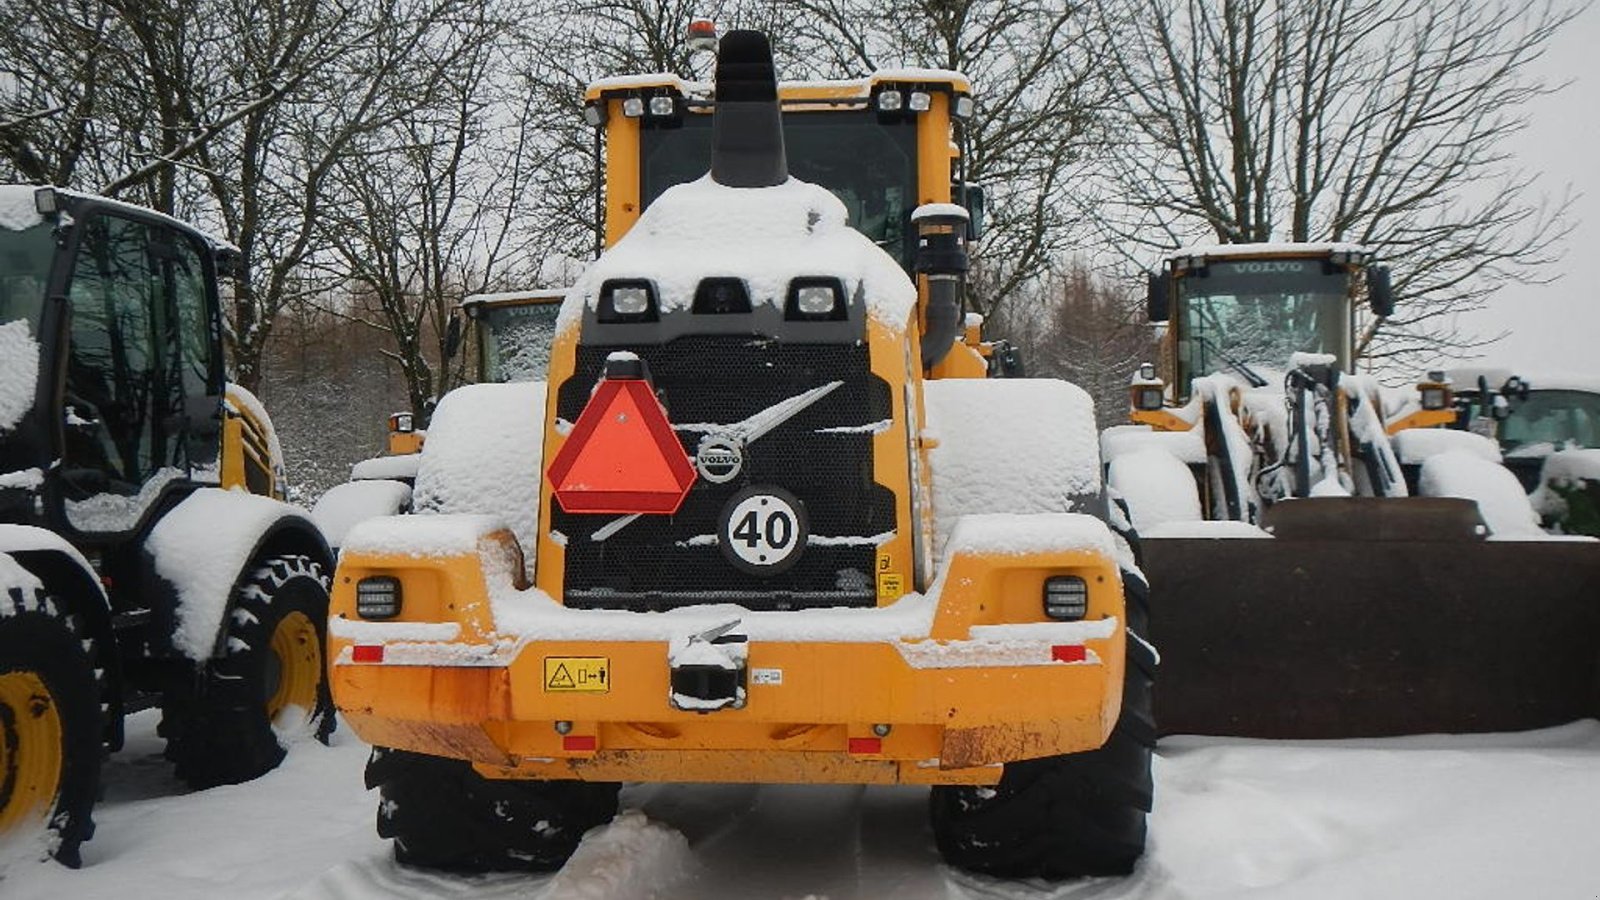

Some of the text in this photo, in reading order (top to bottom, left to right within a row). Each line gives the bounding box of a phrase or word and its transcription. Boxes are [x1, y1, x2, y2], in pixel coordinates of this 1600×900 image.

[1233, 262, 1303, 273] VOLVO
[700, 456, 740, 464] VOLVO
[733, 511, 792, 549] 40
